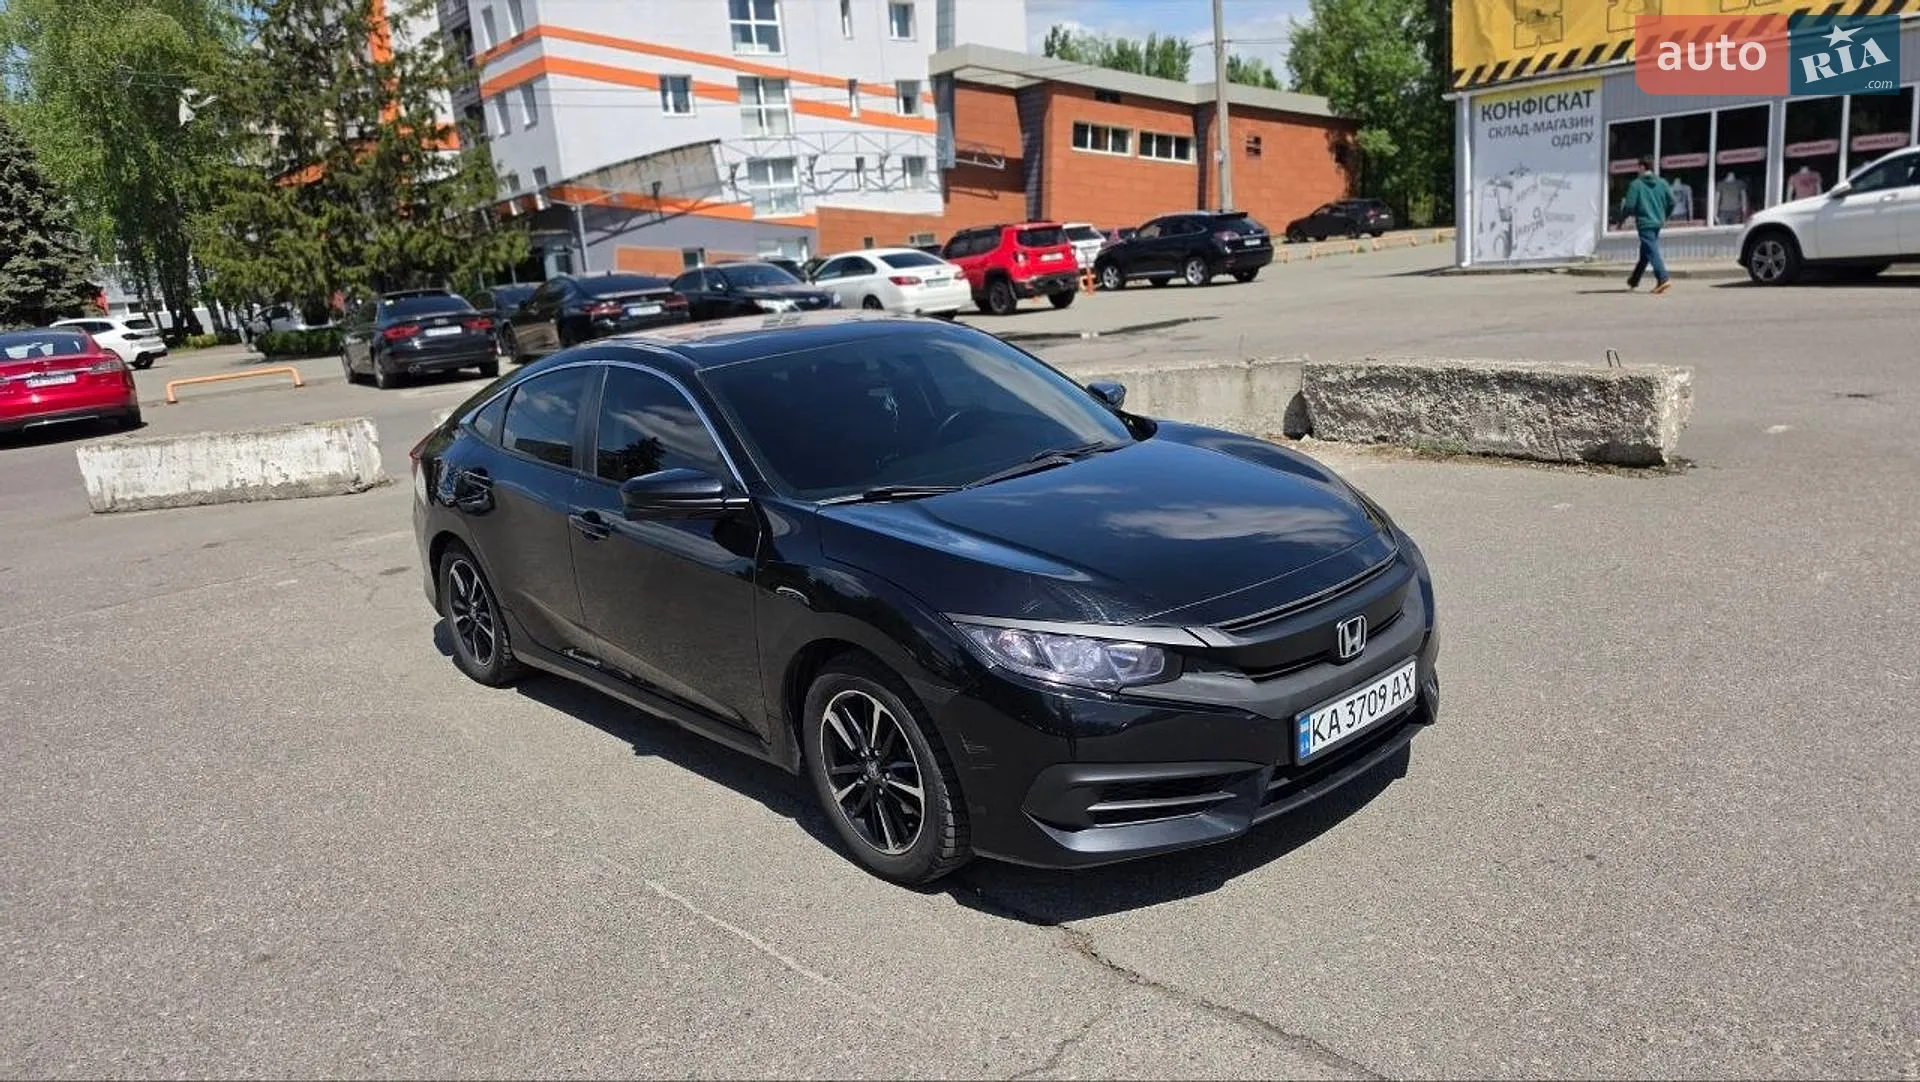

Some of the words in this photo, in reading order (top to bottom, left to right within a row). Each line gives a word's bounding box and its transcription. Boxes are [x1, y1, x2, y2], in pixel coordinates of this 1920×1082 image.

[1481, 89, 1595, 122] КОНФІСКАТ
[1488, 116, 1594, 139] СКЛАД-МАГАЗИН
[1551, 132, 1594, 147] ОДЯГУ
[1312, 708, 1341, 747] KA
[1345, 684, 1388, 729] 3709
[1391, 667, 1414, 706] AX
